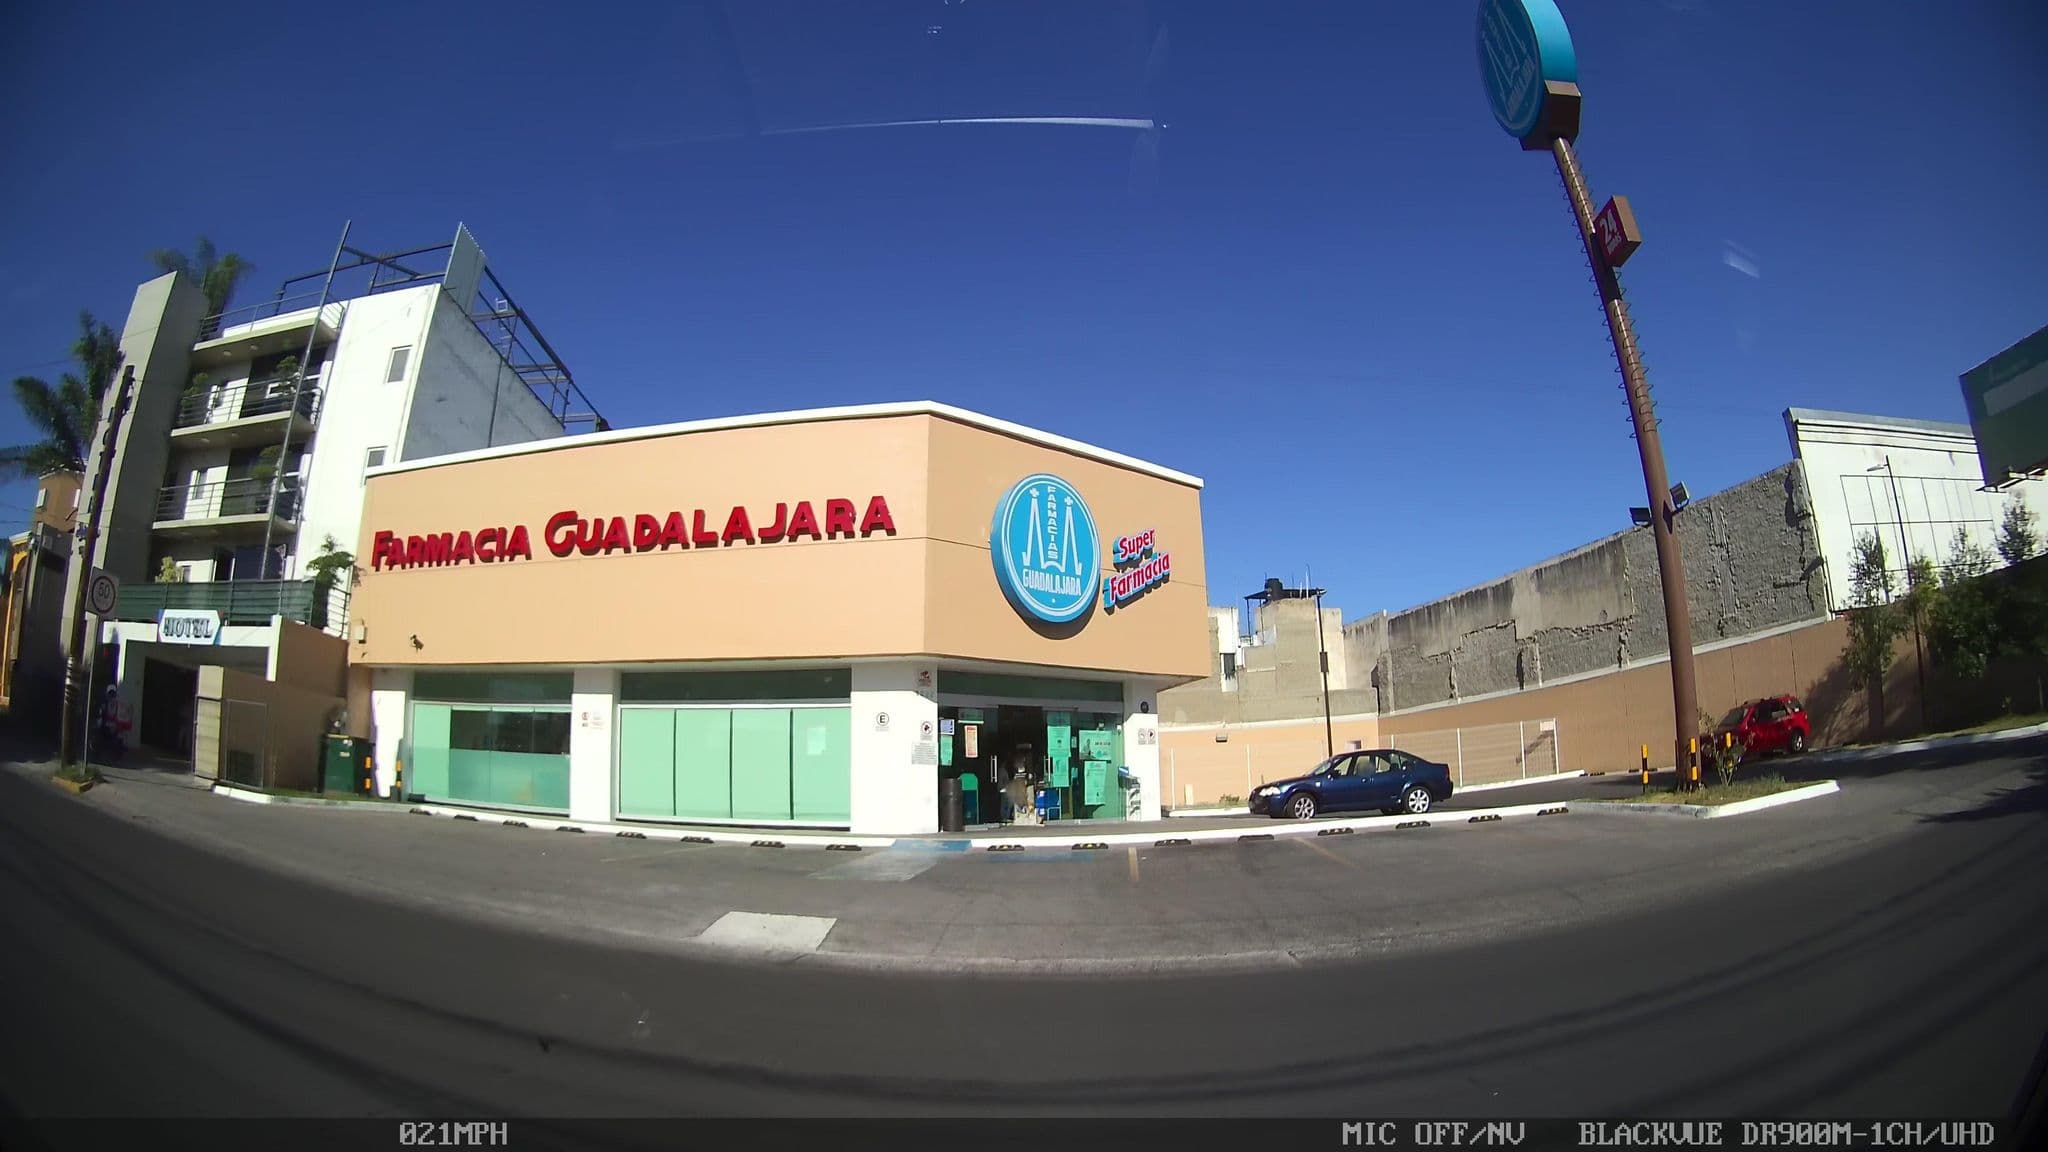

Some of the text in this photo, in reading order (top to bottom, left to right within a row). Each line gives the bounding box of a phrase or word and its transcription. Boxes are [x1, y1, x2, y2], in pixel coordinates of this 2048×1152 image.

[1599, 209, 1618, 246] 24
[371, 494, 897, 572] FARMACIA GUADALAJARA
[1047, 485, 1058, 560] FARMACIAS
[1117, 527, 1156, 559] Super
[99, 581, 111, 599] 50
[1022, 568, 1082, 597] GUADALAJARA
[1108, 551, 1171, 603] Farmacia
[163, 616, 213, 639] HOTEL
